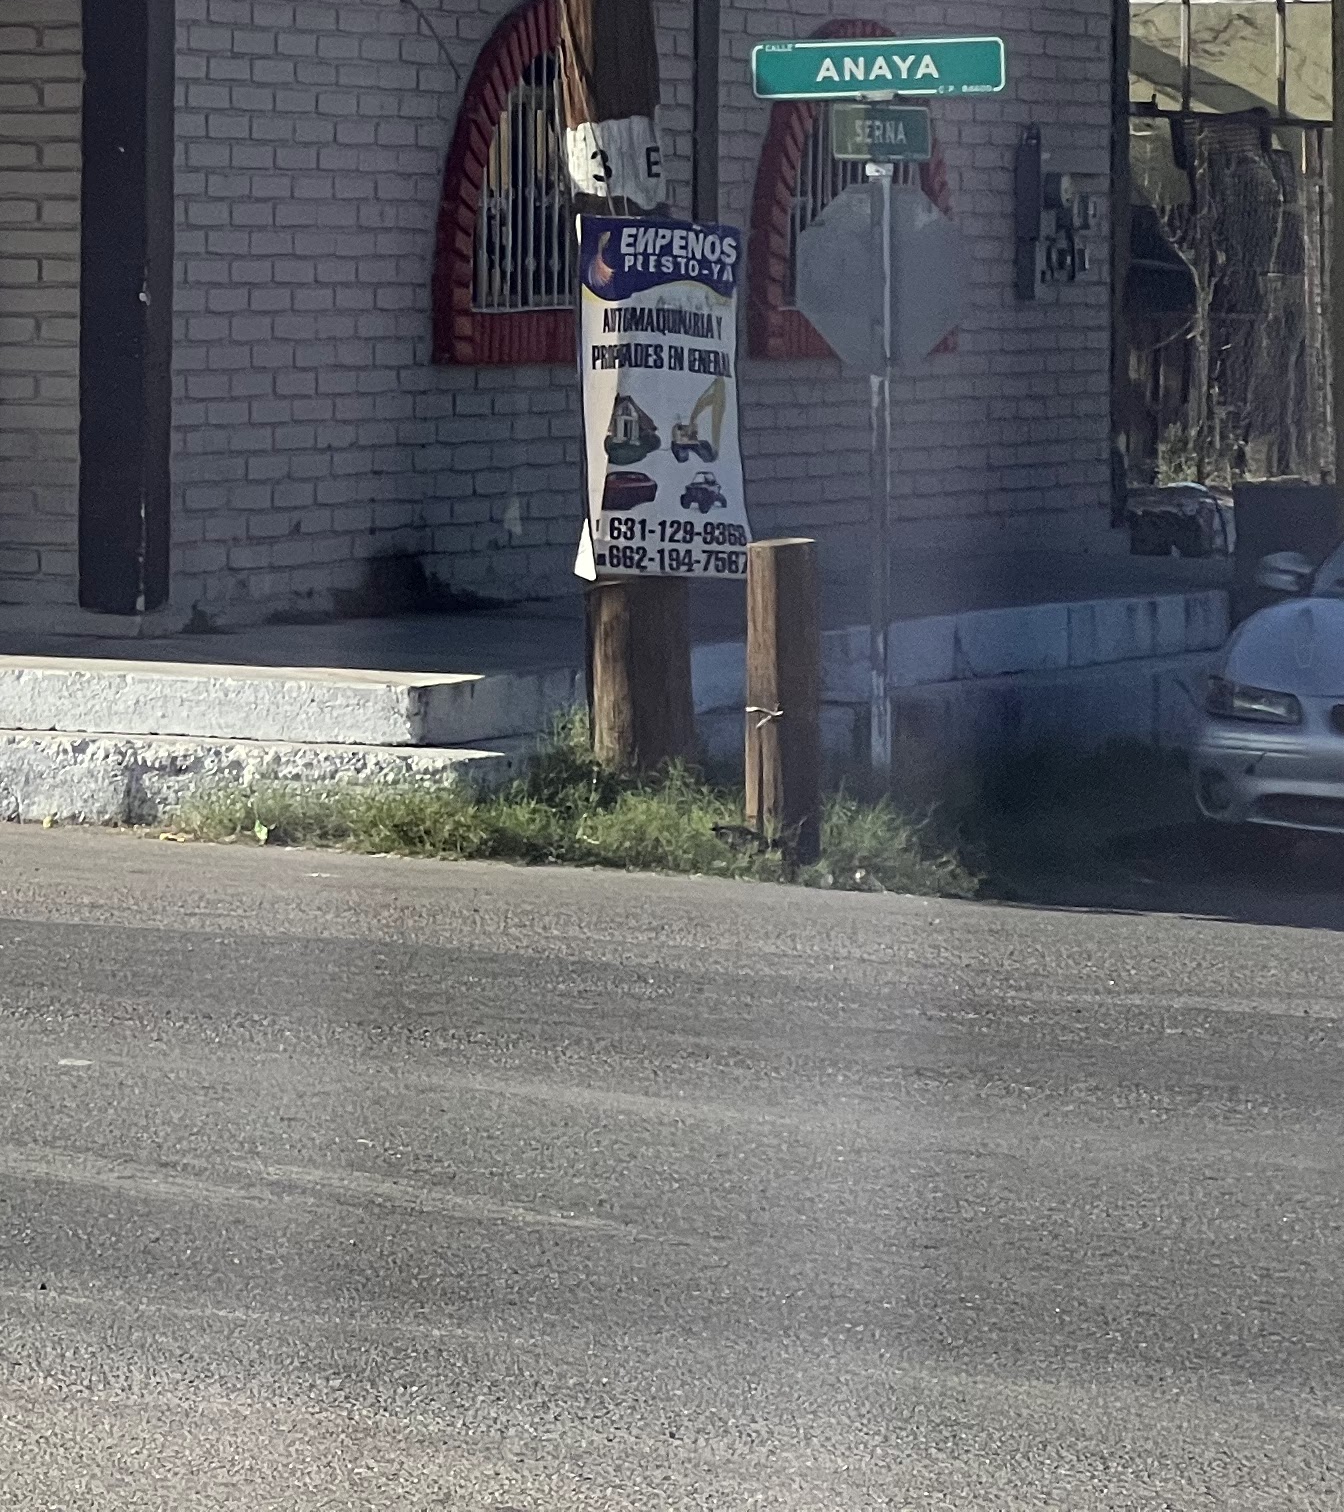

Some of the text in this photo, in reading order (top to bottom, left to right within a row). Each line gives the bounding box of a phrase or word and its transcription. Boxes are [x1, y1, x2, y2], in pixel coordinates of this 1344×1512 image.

[816, 54, 940, 82] ANAYA
[854, 120, 908, 145] SERNA
[645, 145, 662, 179] E
[668, 344, 685, 371] EN
